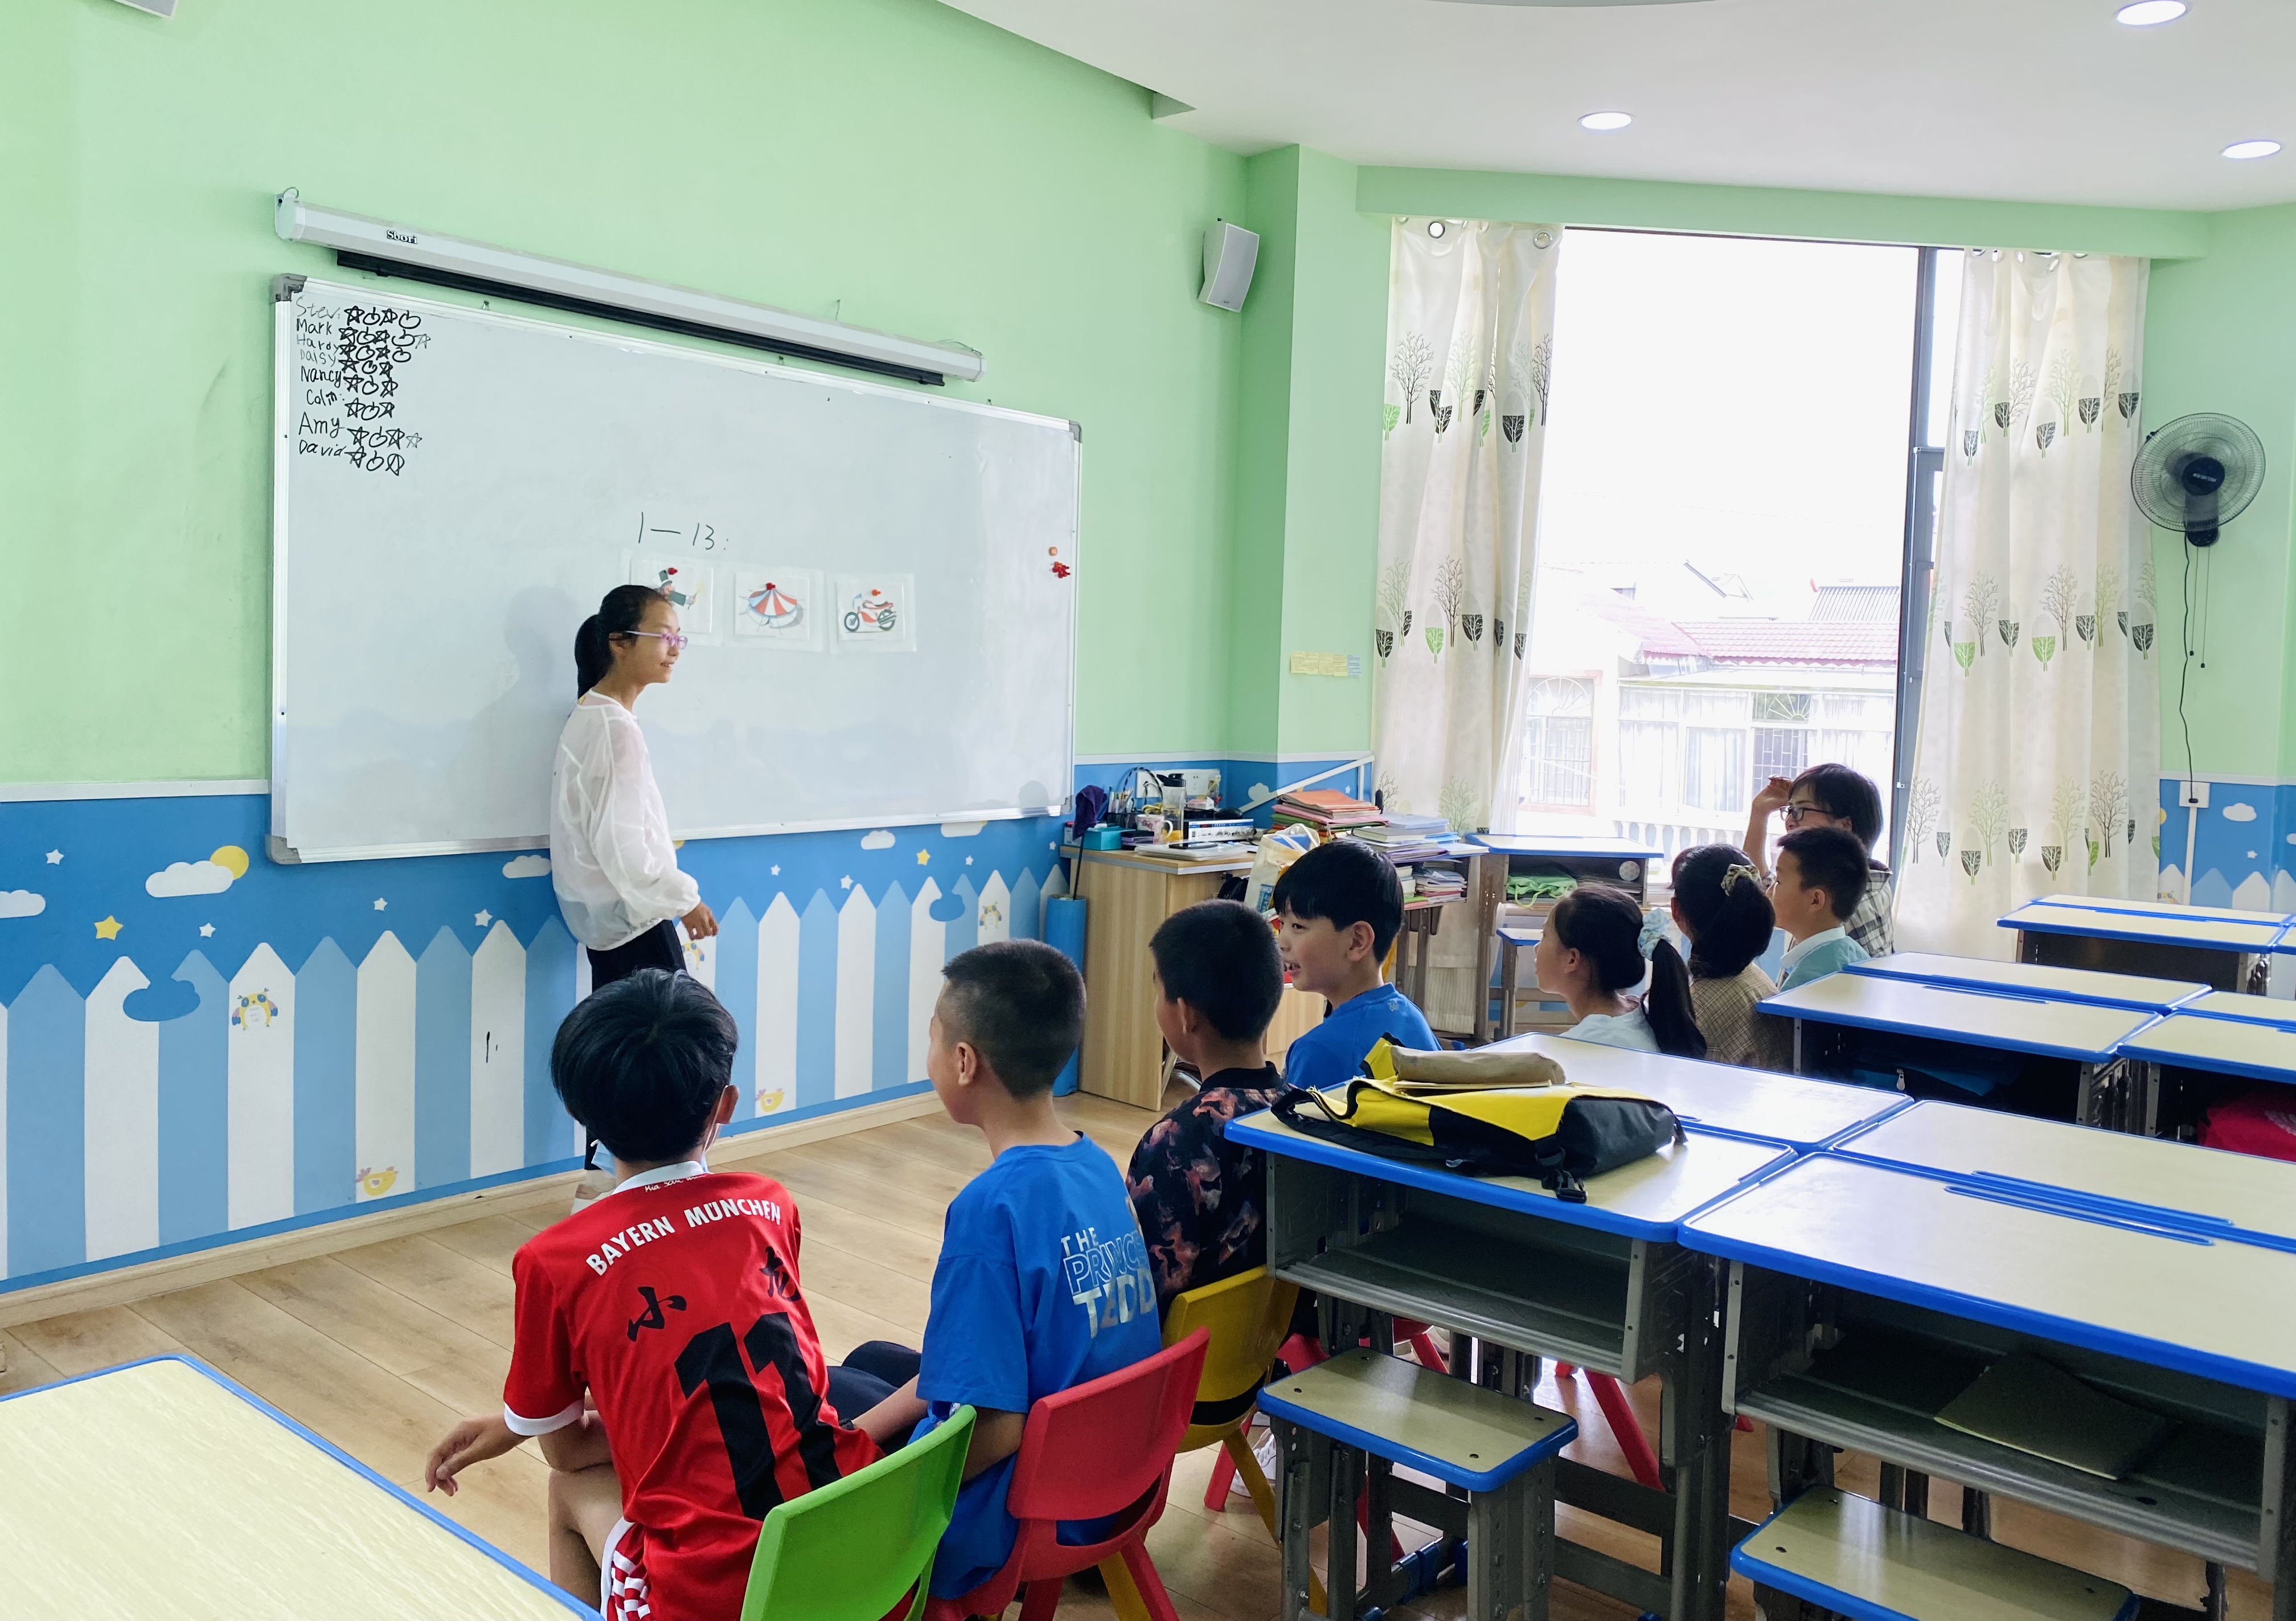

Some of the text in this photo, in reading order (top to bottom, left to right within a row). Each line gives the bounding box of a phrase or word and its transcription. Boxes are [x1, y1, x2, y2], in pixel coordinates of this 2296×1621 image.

[296, 318, 332, 335] Mark
[299, 439, 347, 457] David
[585, 1198, 781, 1276] BAYERN MÜNCHEN
[1061, 1227, 1099, 1257] THE
[674, 1312, 843, 1521] 11
